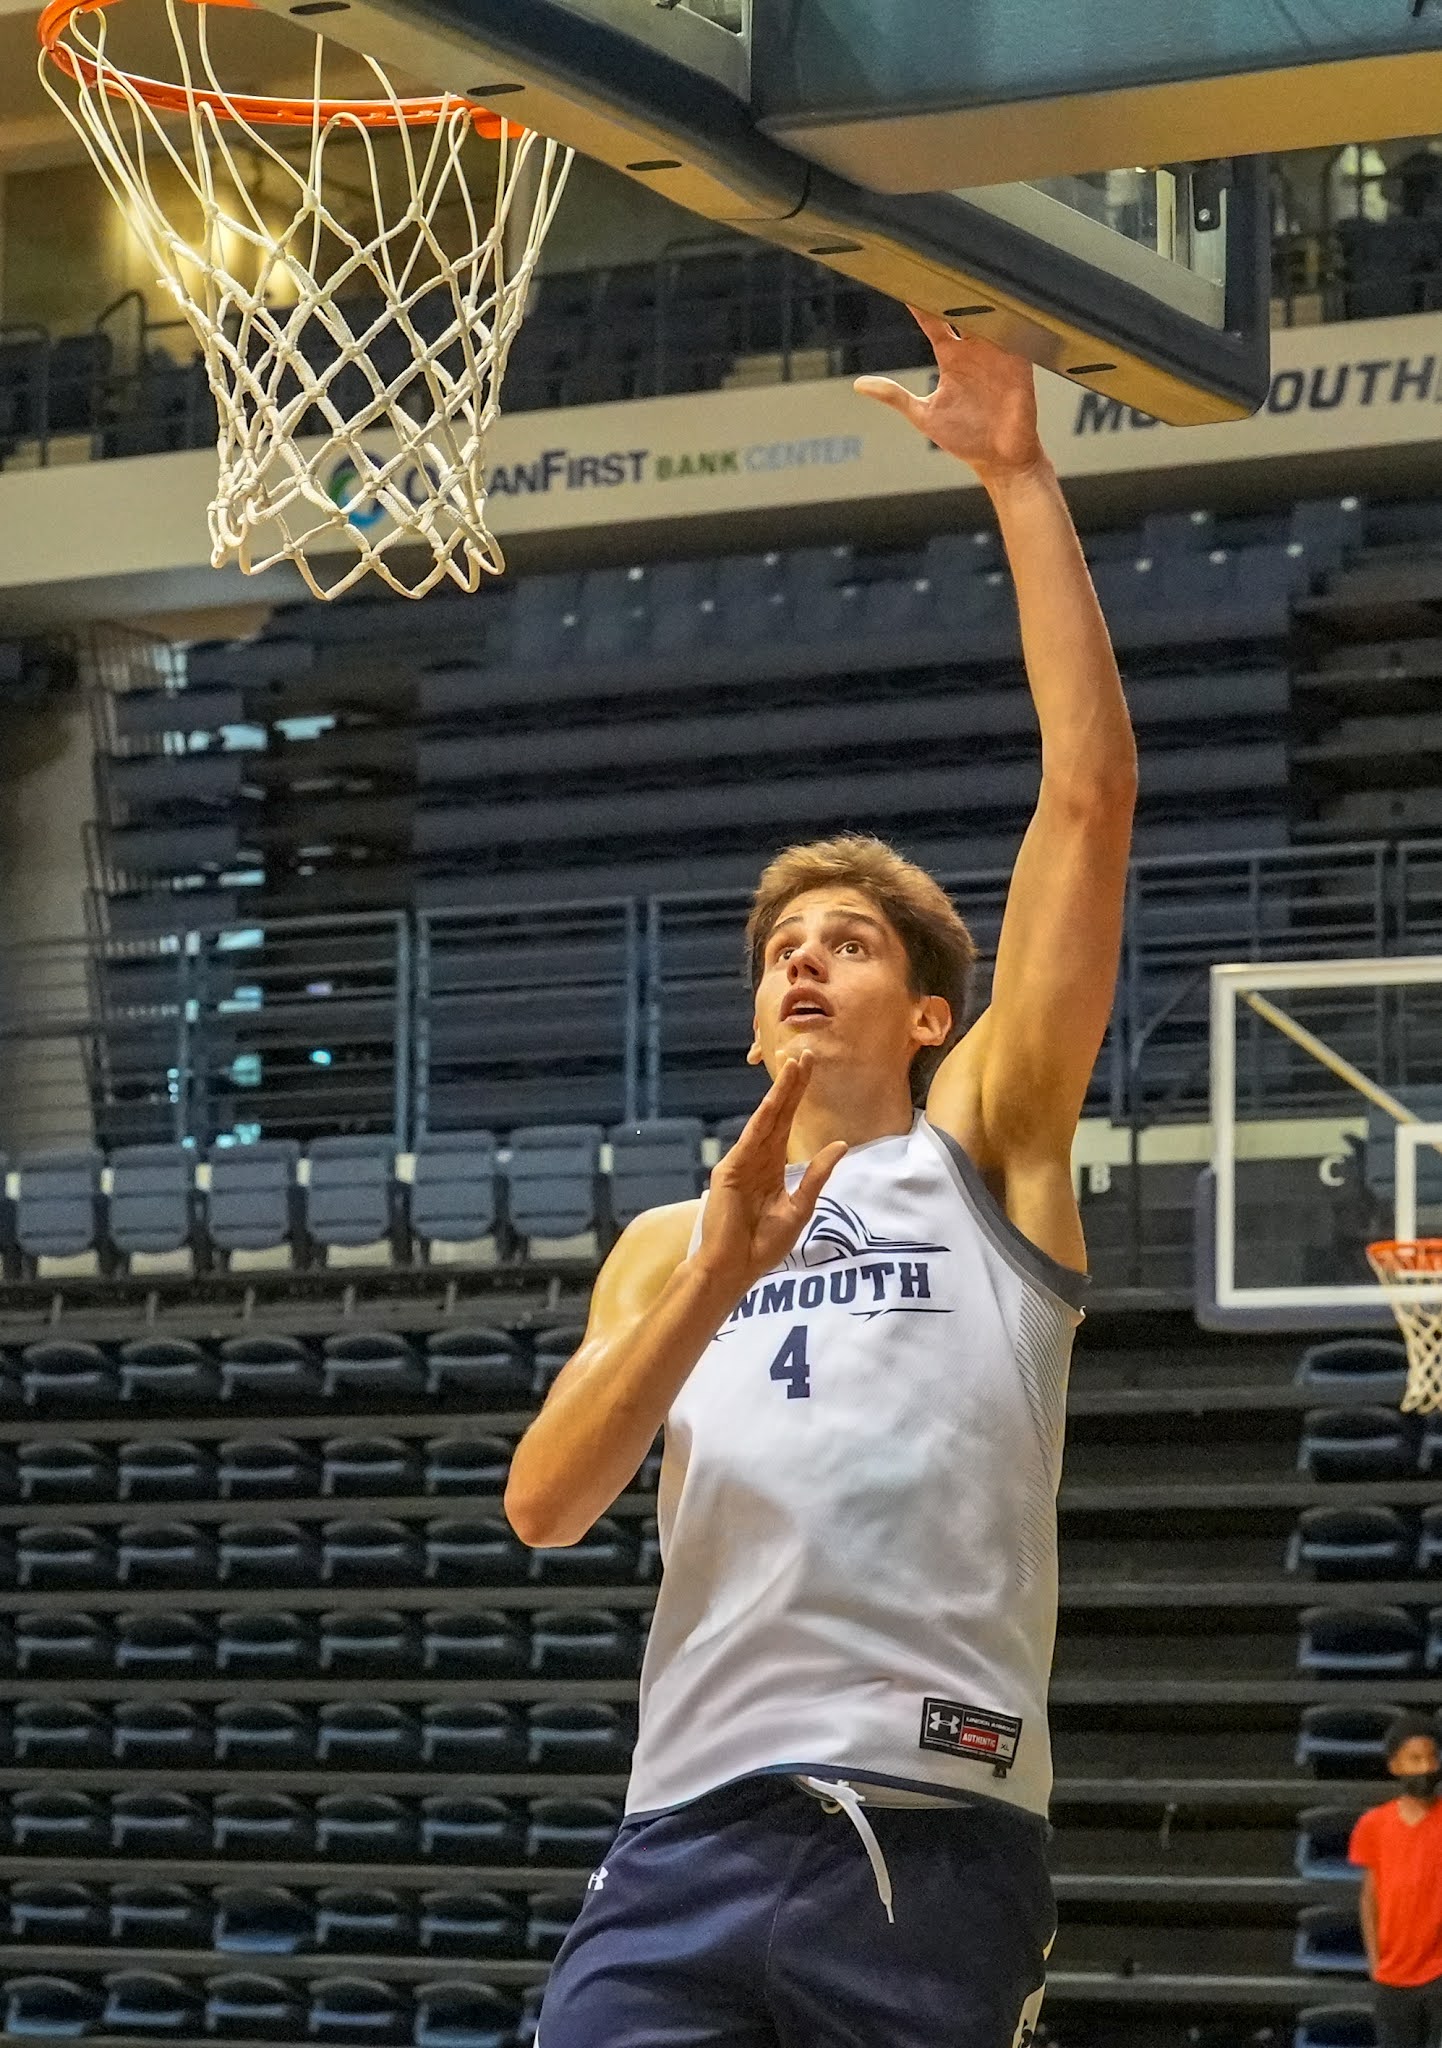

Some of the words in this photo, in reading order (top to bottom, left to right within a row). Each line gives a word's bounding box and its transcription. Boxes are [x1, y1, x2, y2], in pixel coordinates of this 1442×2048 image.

[404, 446, 649, 505] OANFIRST
[655, 450, 739, 483] BANK
[745, 434, 864, 472] CENTER
[1319, 1156, 1345, 1187] C
[729, 1262, 931, 1323] NMOUTH
[769, 1325, 810, 1399] 4
[962, 1732, 997, 1748] AUTHENTIC
[1000, 1743, 1010, 1752] XL
[966, 1716, 990, 1727] UNDER
